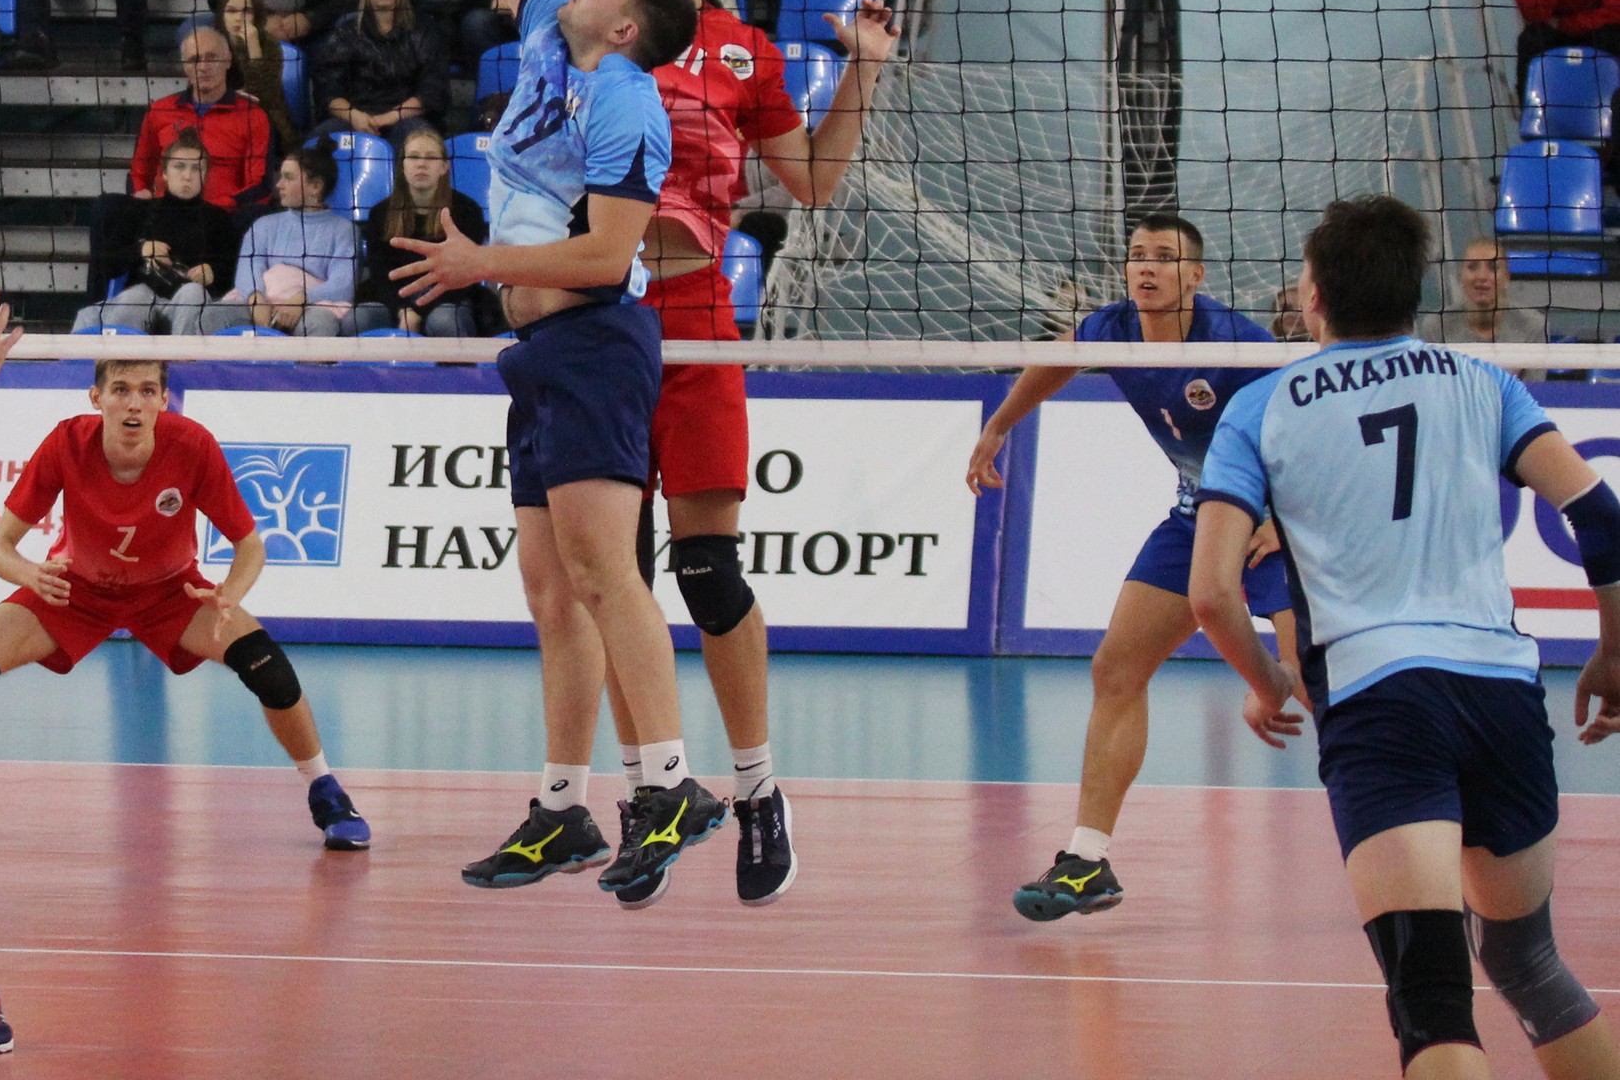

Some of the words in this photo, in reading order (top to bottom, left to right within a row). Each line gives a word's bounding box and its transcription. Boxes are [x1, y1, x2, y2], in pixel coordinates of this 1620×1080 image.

[1289, 349, 1459, 408] САХАЛИН
[1357, 403, 1419, 521] 7
[382, 525, 518, 571] НАУ
[736, 530, 940, 576] ПОРТ
